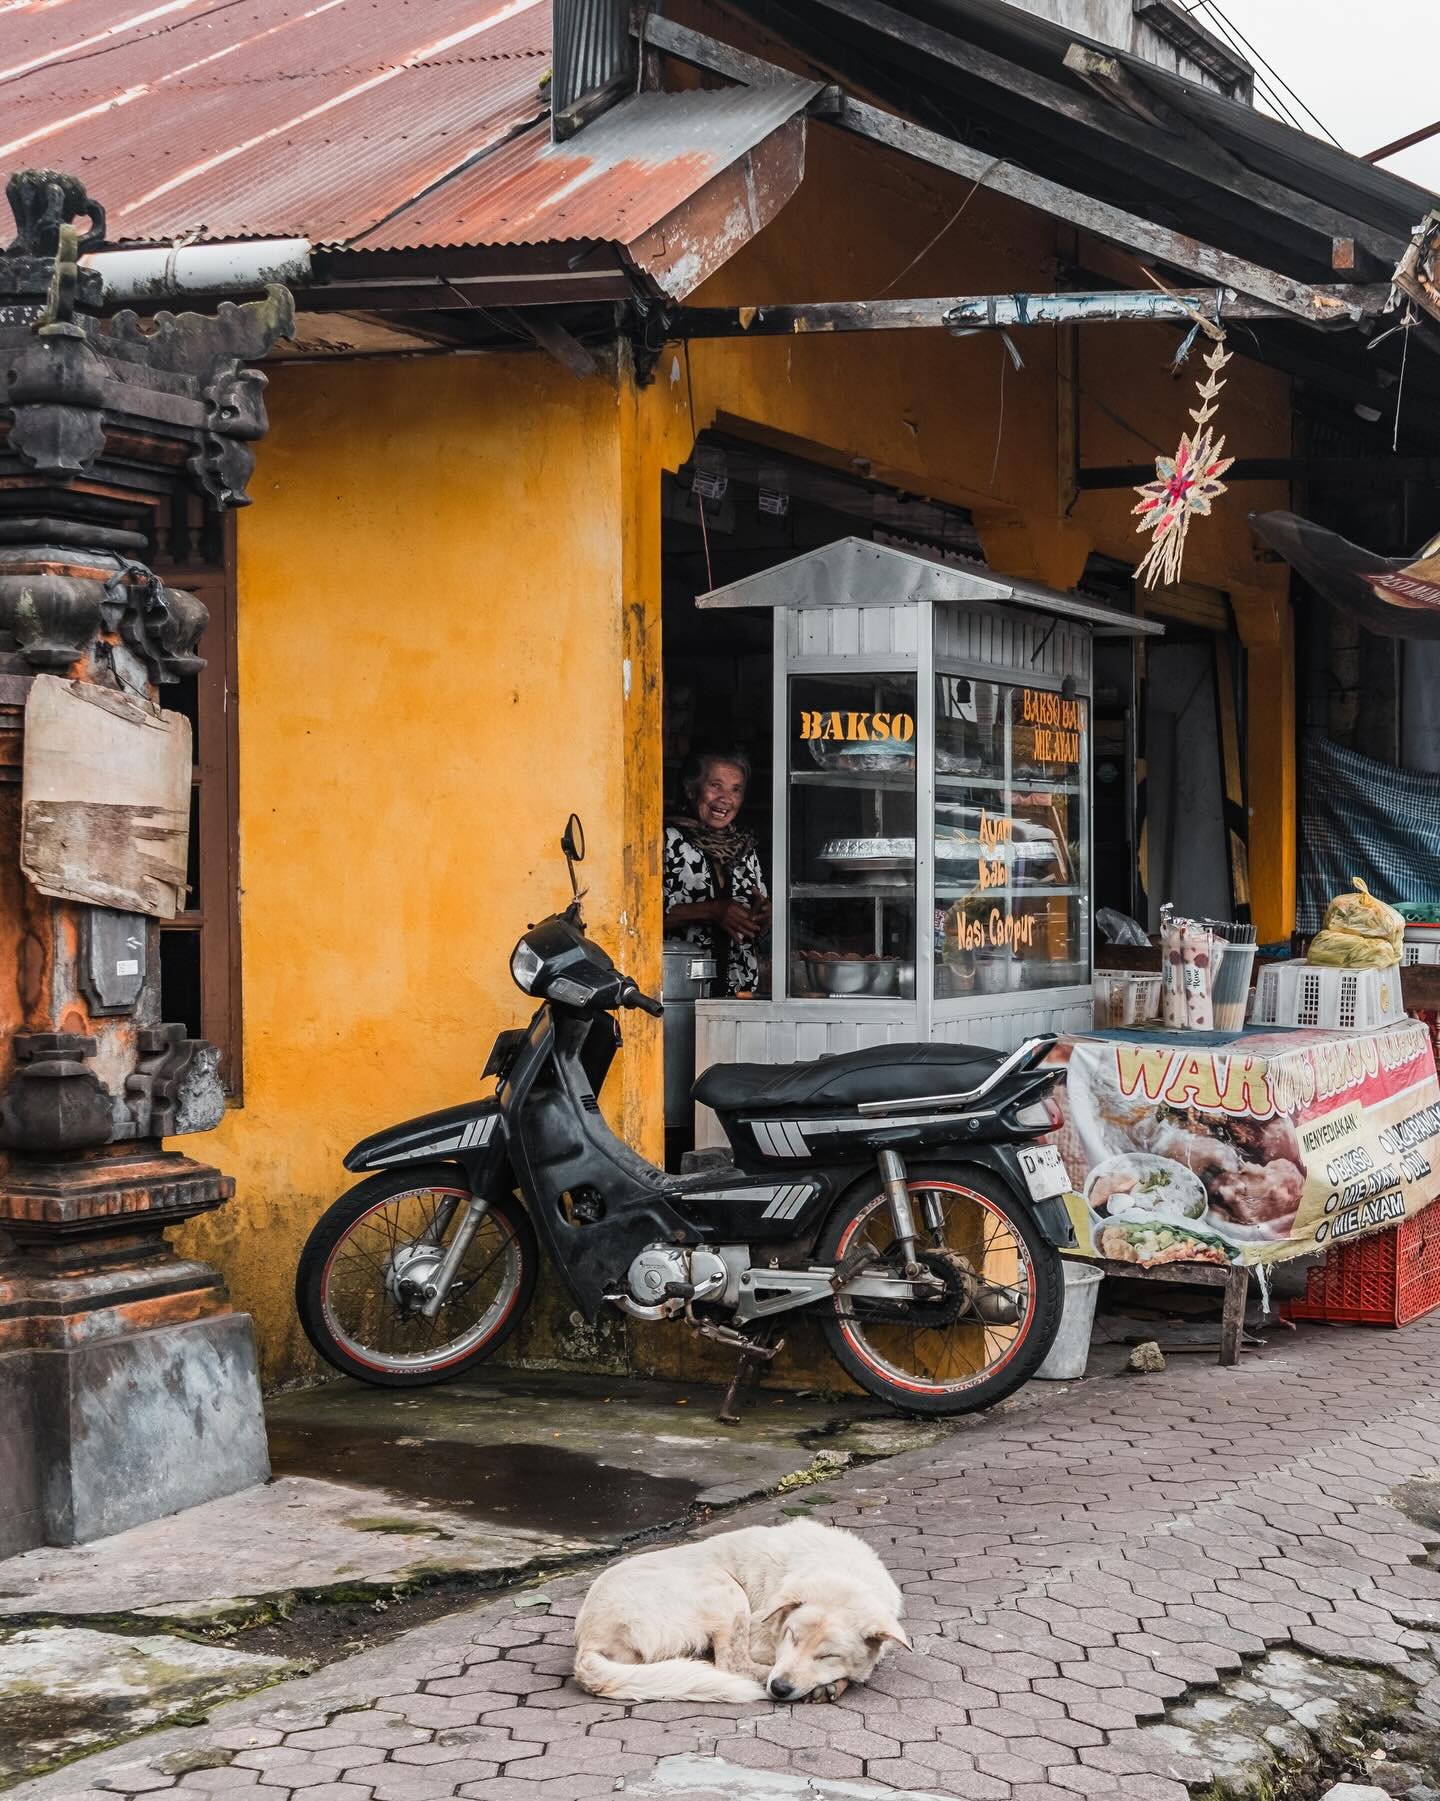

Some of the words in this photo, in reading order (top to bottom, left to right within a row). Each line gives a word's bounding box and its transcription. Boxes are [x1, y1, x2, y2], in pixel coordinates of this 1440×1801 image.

[1023, 689, 1060, 726] BAKSO
[800, 711, 914, 742] BAKSO
[1053, 731, 1079, 763] AYAM
[957, 912, 984, 951] Nasi
[989, 908, 1035, 952] Campur
[1333, 1146, 1374, 1182] BAKSO
[1339, 1179, 1366, 1211] MIE
[1331, 1207, 1359, 1238] MIE
[1360, 1191, 1405, 1228] AYAM
